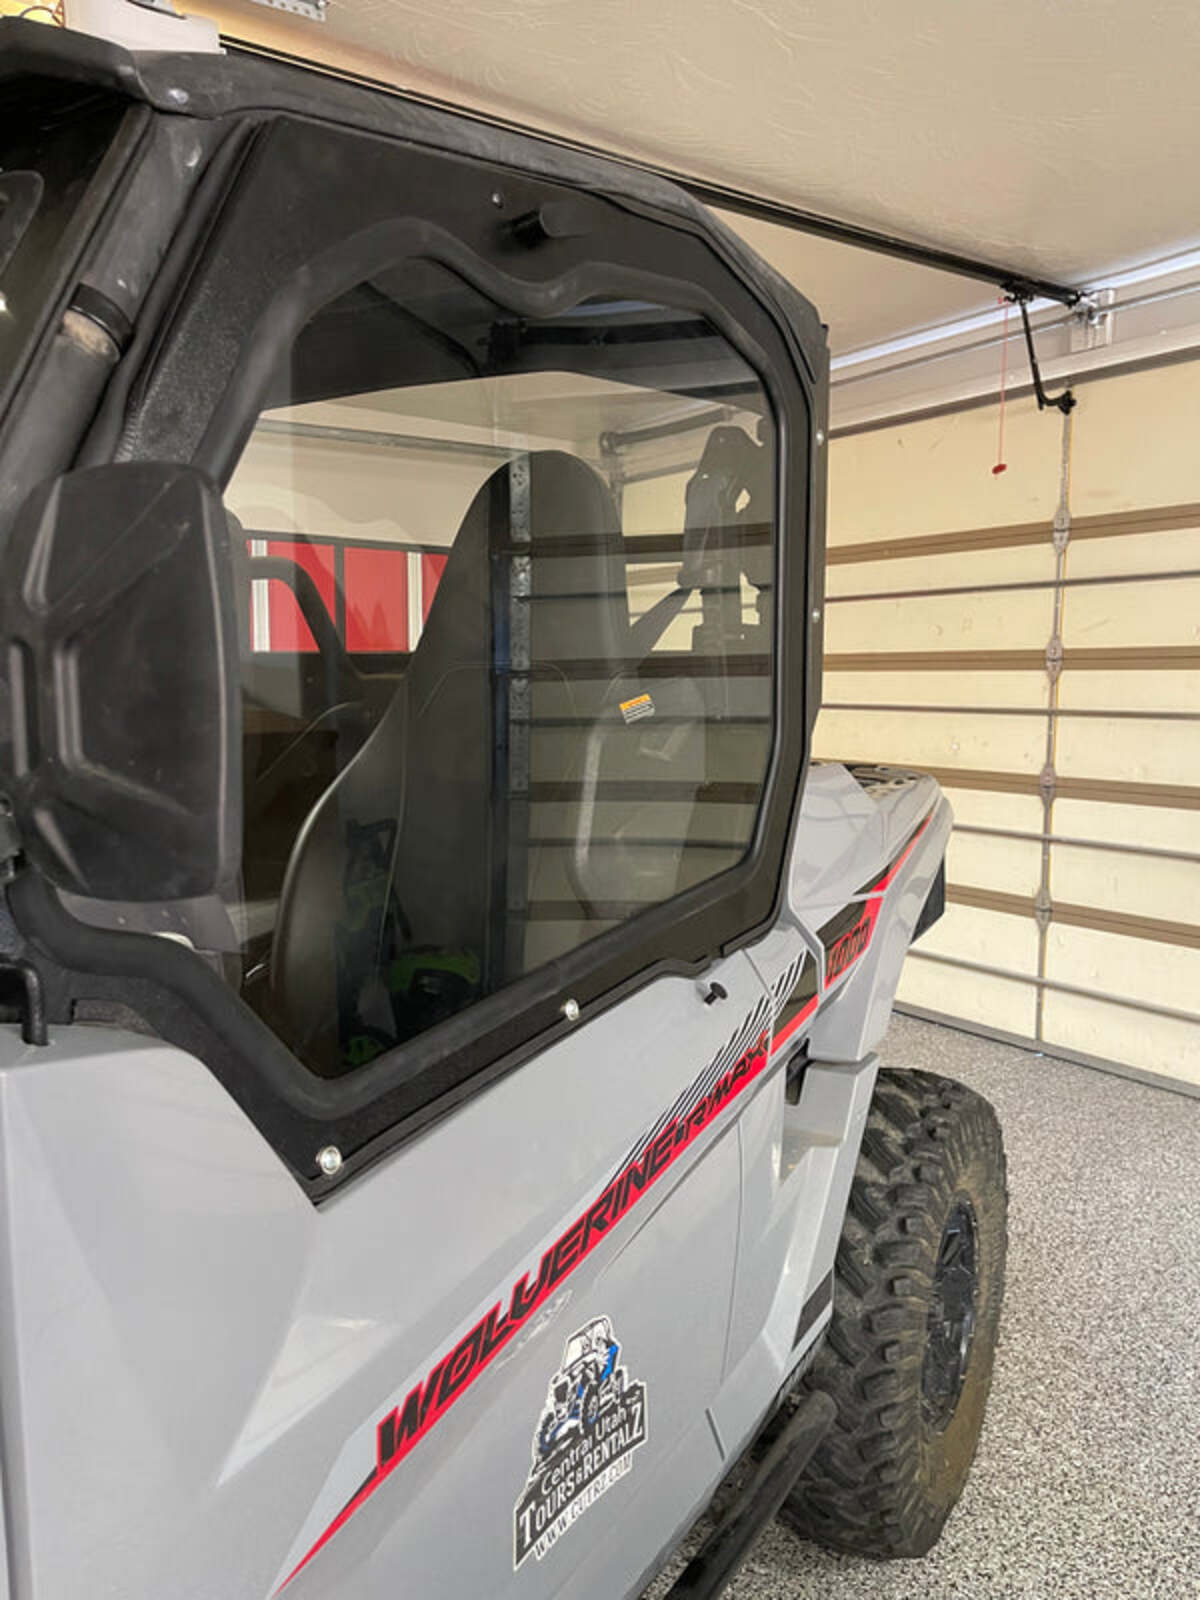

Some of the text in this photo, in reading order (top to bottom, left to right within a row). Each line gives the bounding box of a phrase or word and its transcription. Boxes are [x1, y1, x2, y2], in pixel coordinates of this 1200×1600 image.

[378, 1122, 676, 1462] WOLVERINE
[541, 1405, 628, 1496] Central Utah
